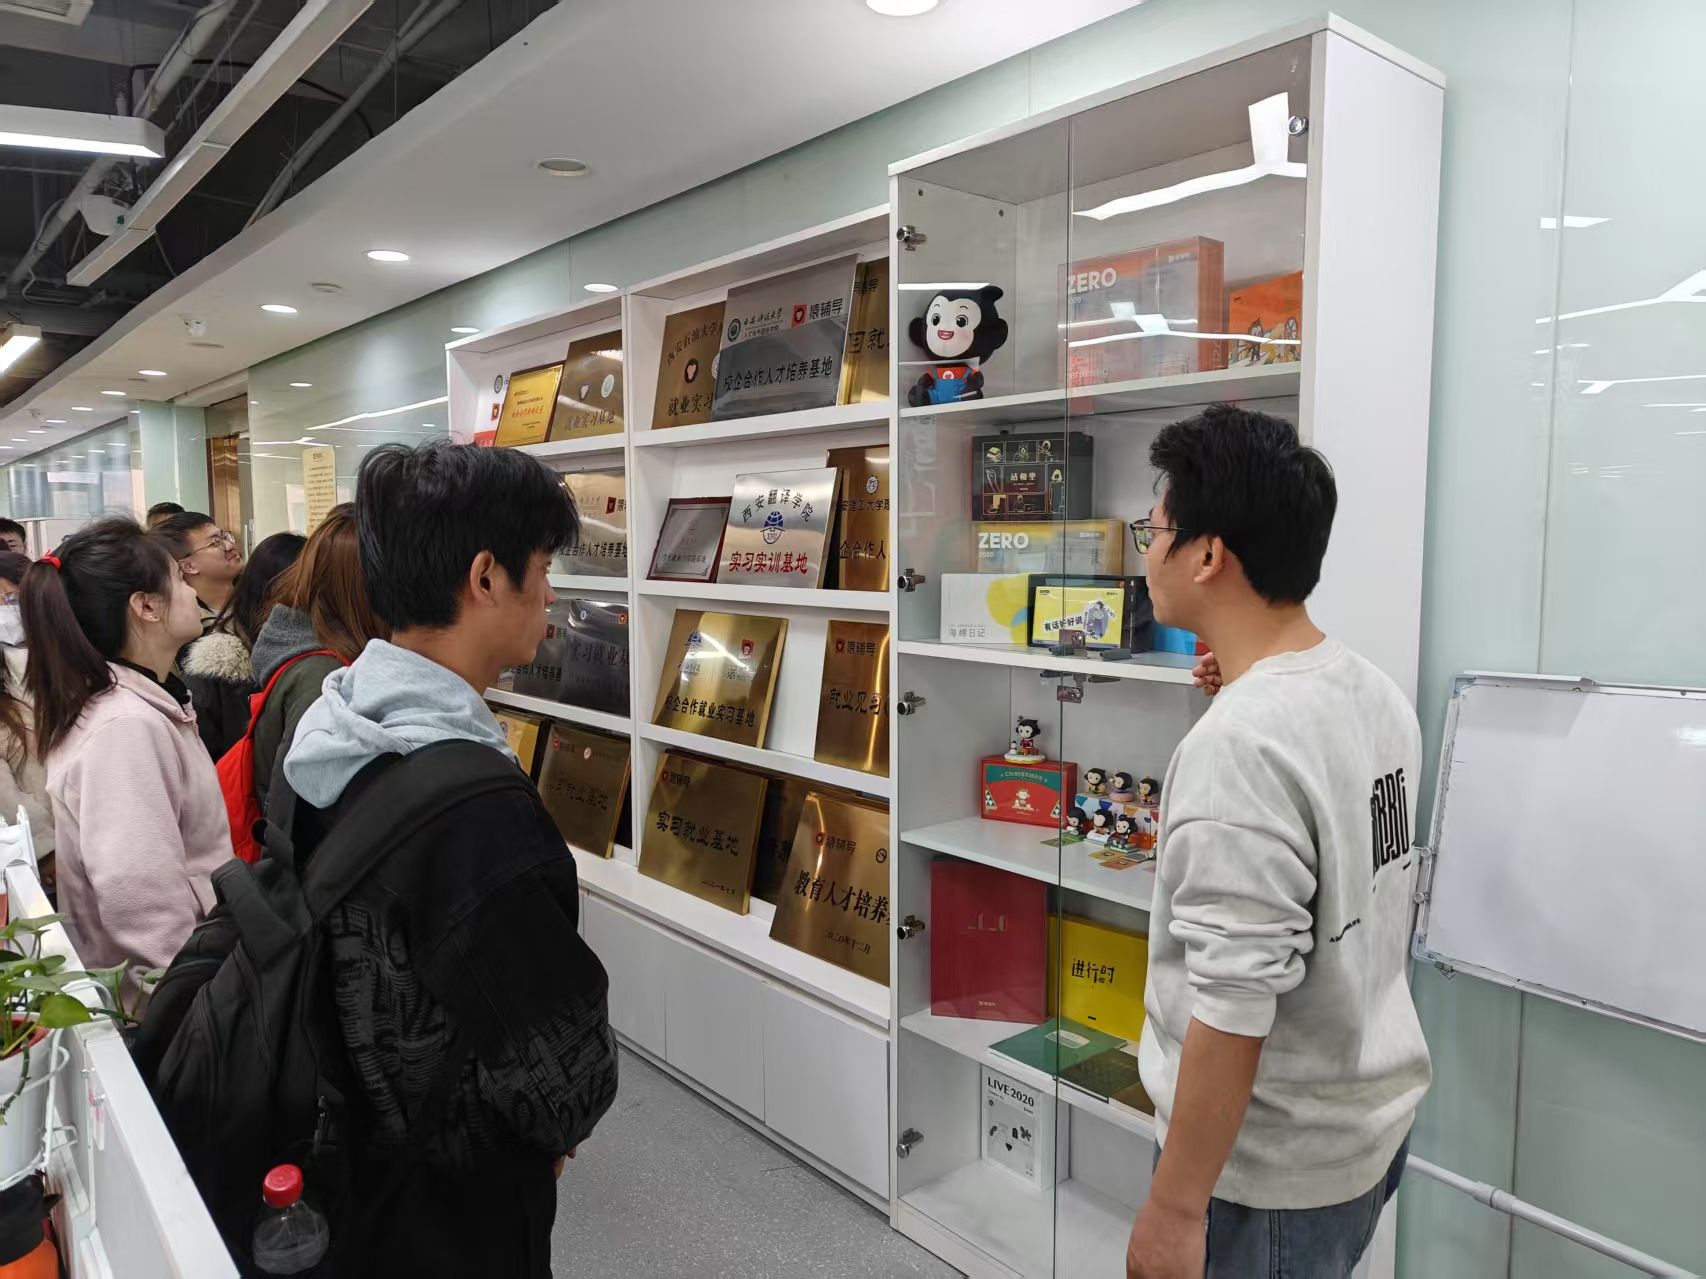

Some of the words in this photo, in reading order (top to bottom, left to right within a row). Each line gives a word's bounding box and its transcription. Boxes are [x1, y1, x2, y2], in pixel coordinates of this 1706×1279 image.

[1067, 267, 1117, 293] ZERO
[809, 298, 843, 320] 猿辅导
[723, 355, 833, 393] 校企合作人才培养基地
[741, 488, 814, 523] 西安翻译学院
[977, 532, 1029, 549] ZERO
[729, 551, 808, 575] 实习实训基地
[665, 692, 755, 727] 校企合作就业实习基地
[656, 810, 739, 857] 实习就业基地
[794, 869, 889, 926] 教育人才培养
[1072, 958, 1115, 984] 进行时
[987, 1077, 1034, 1107] LIVE2020
